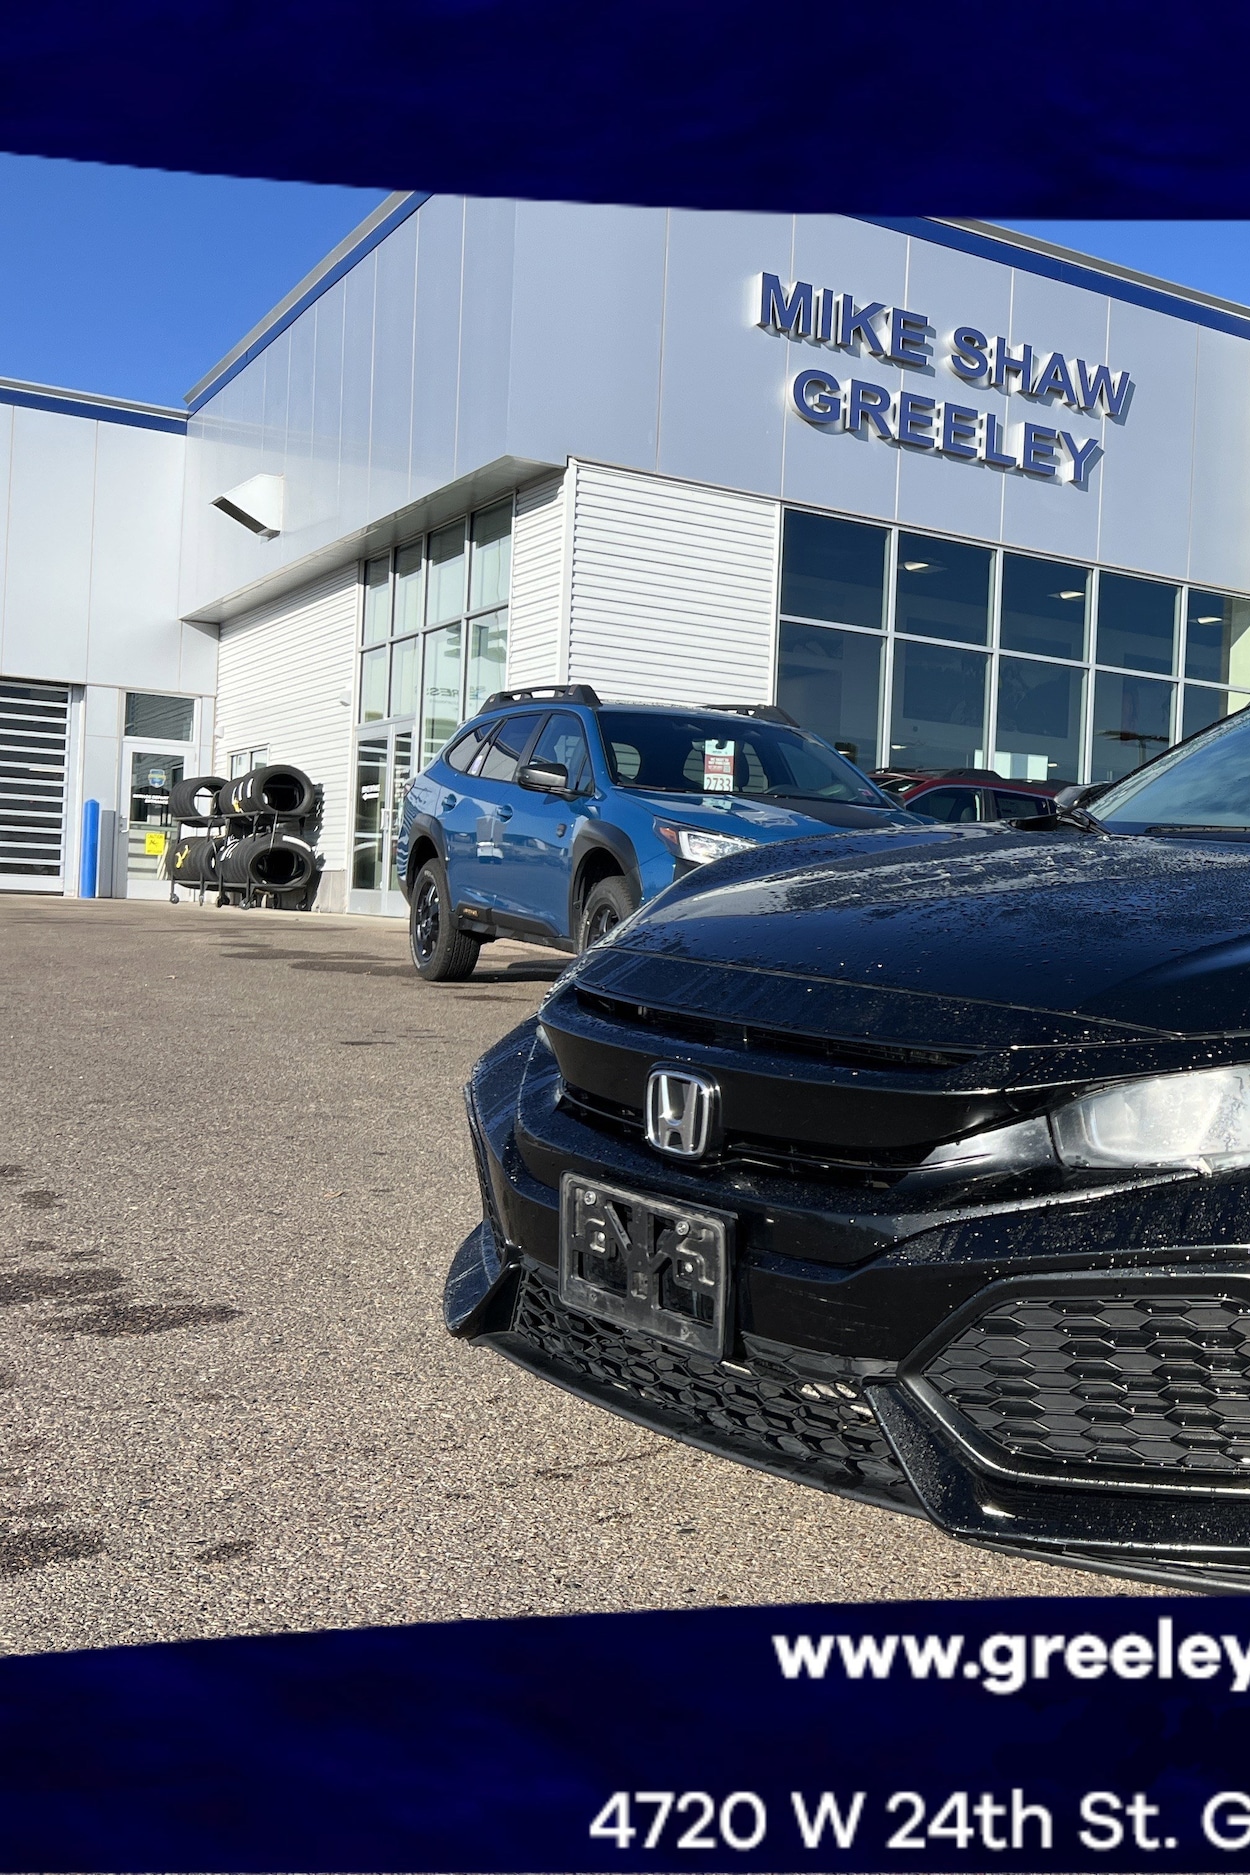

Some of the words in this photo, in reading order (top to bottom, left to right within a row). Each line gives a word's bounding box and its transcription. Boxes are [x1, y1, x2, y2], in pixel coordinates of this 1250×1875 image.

[757, 272, 931, 367] MIKE
[948, 326, 1133, 418] SHAW
[791, 368, 1101, 484] GREELEY
[705, 776, 732, 791] 2733
